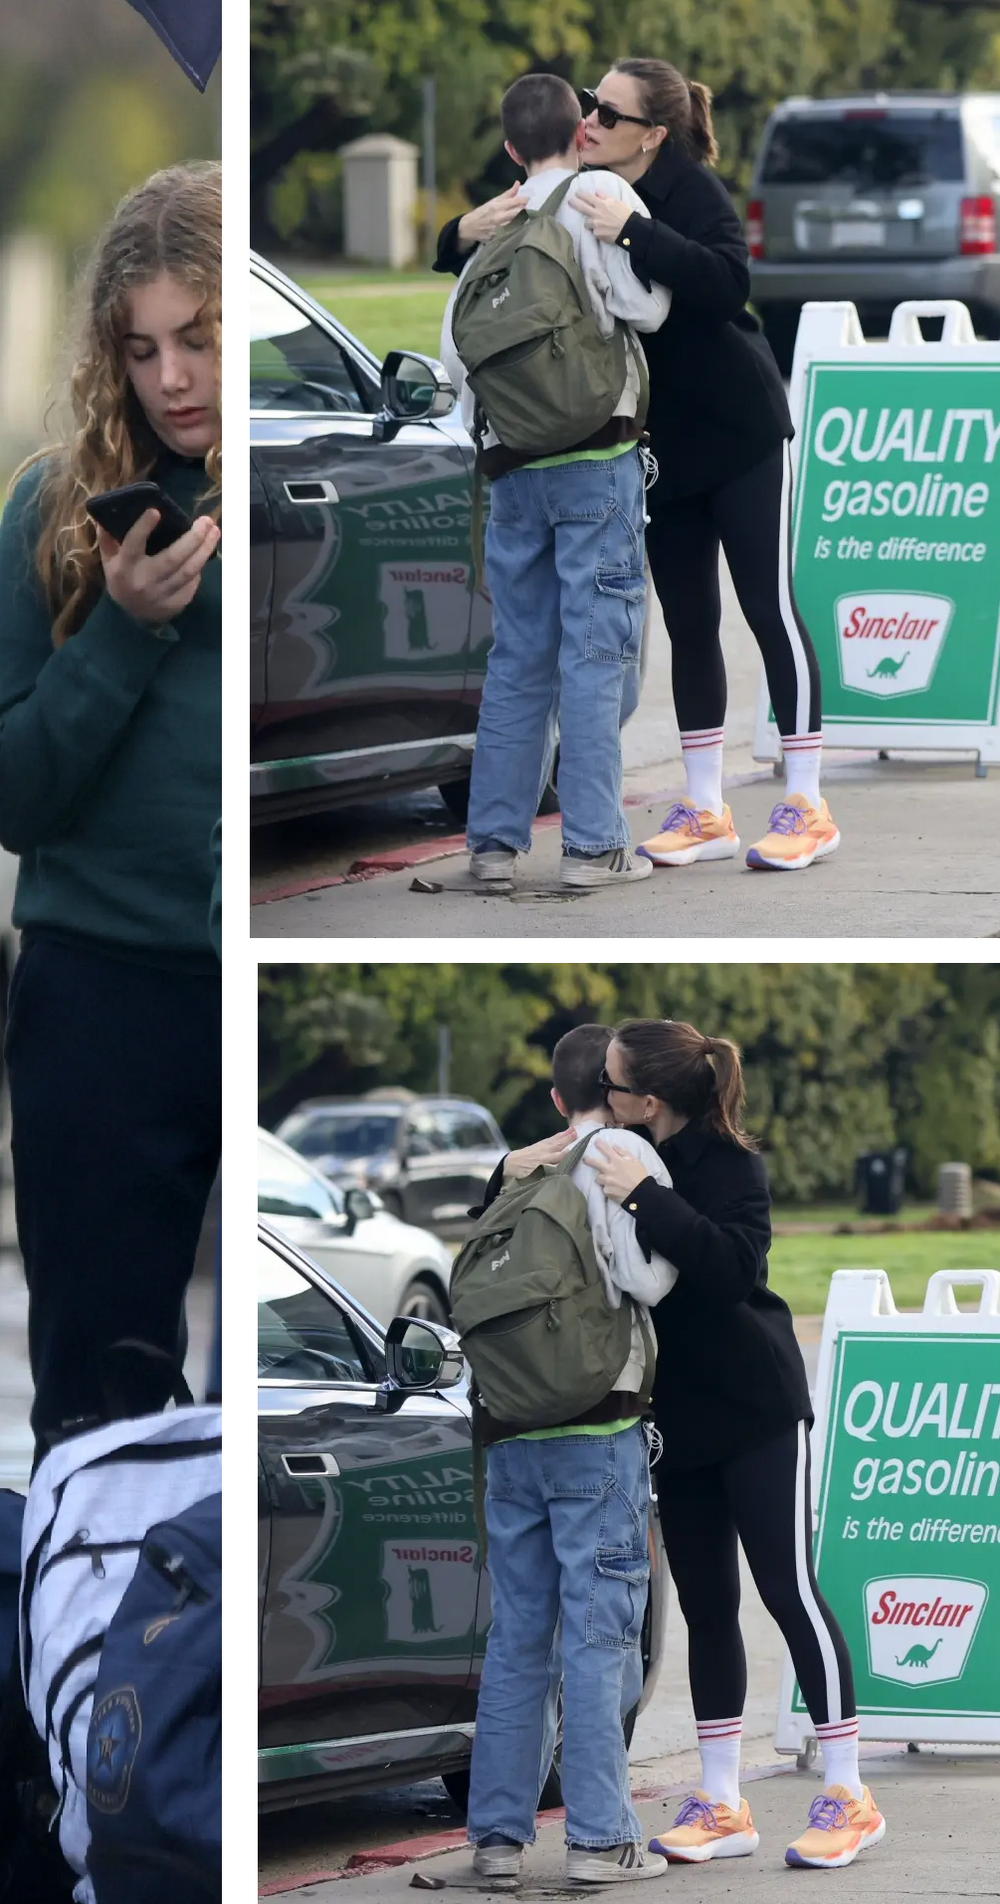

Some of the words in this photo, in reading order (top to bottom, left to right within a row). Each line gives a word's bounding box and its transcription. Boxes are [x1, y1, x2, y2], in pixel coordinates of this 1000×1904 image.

[814, 407, 1000, 466] QUALITY
[821, 473, 989, 522] gasoline
[814, 535, 831, 559] is
[837, 536, 872, 560] the
[877, 536, 986, 562] difference
[843, 606, 940, 641] Sinclair
[842, 1516, 860, 1539] is
[866, 1516, 903, 1542] the
[871, 1590, 974, 1628] Sinclair
